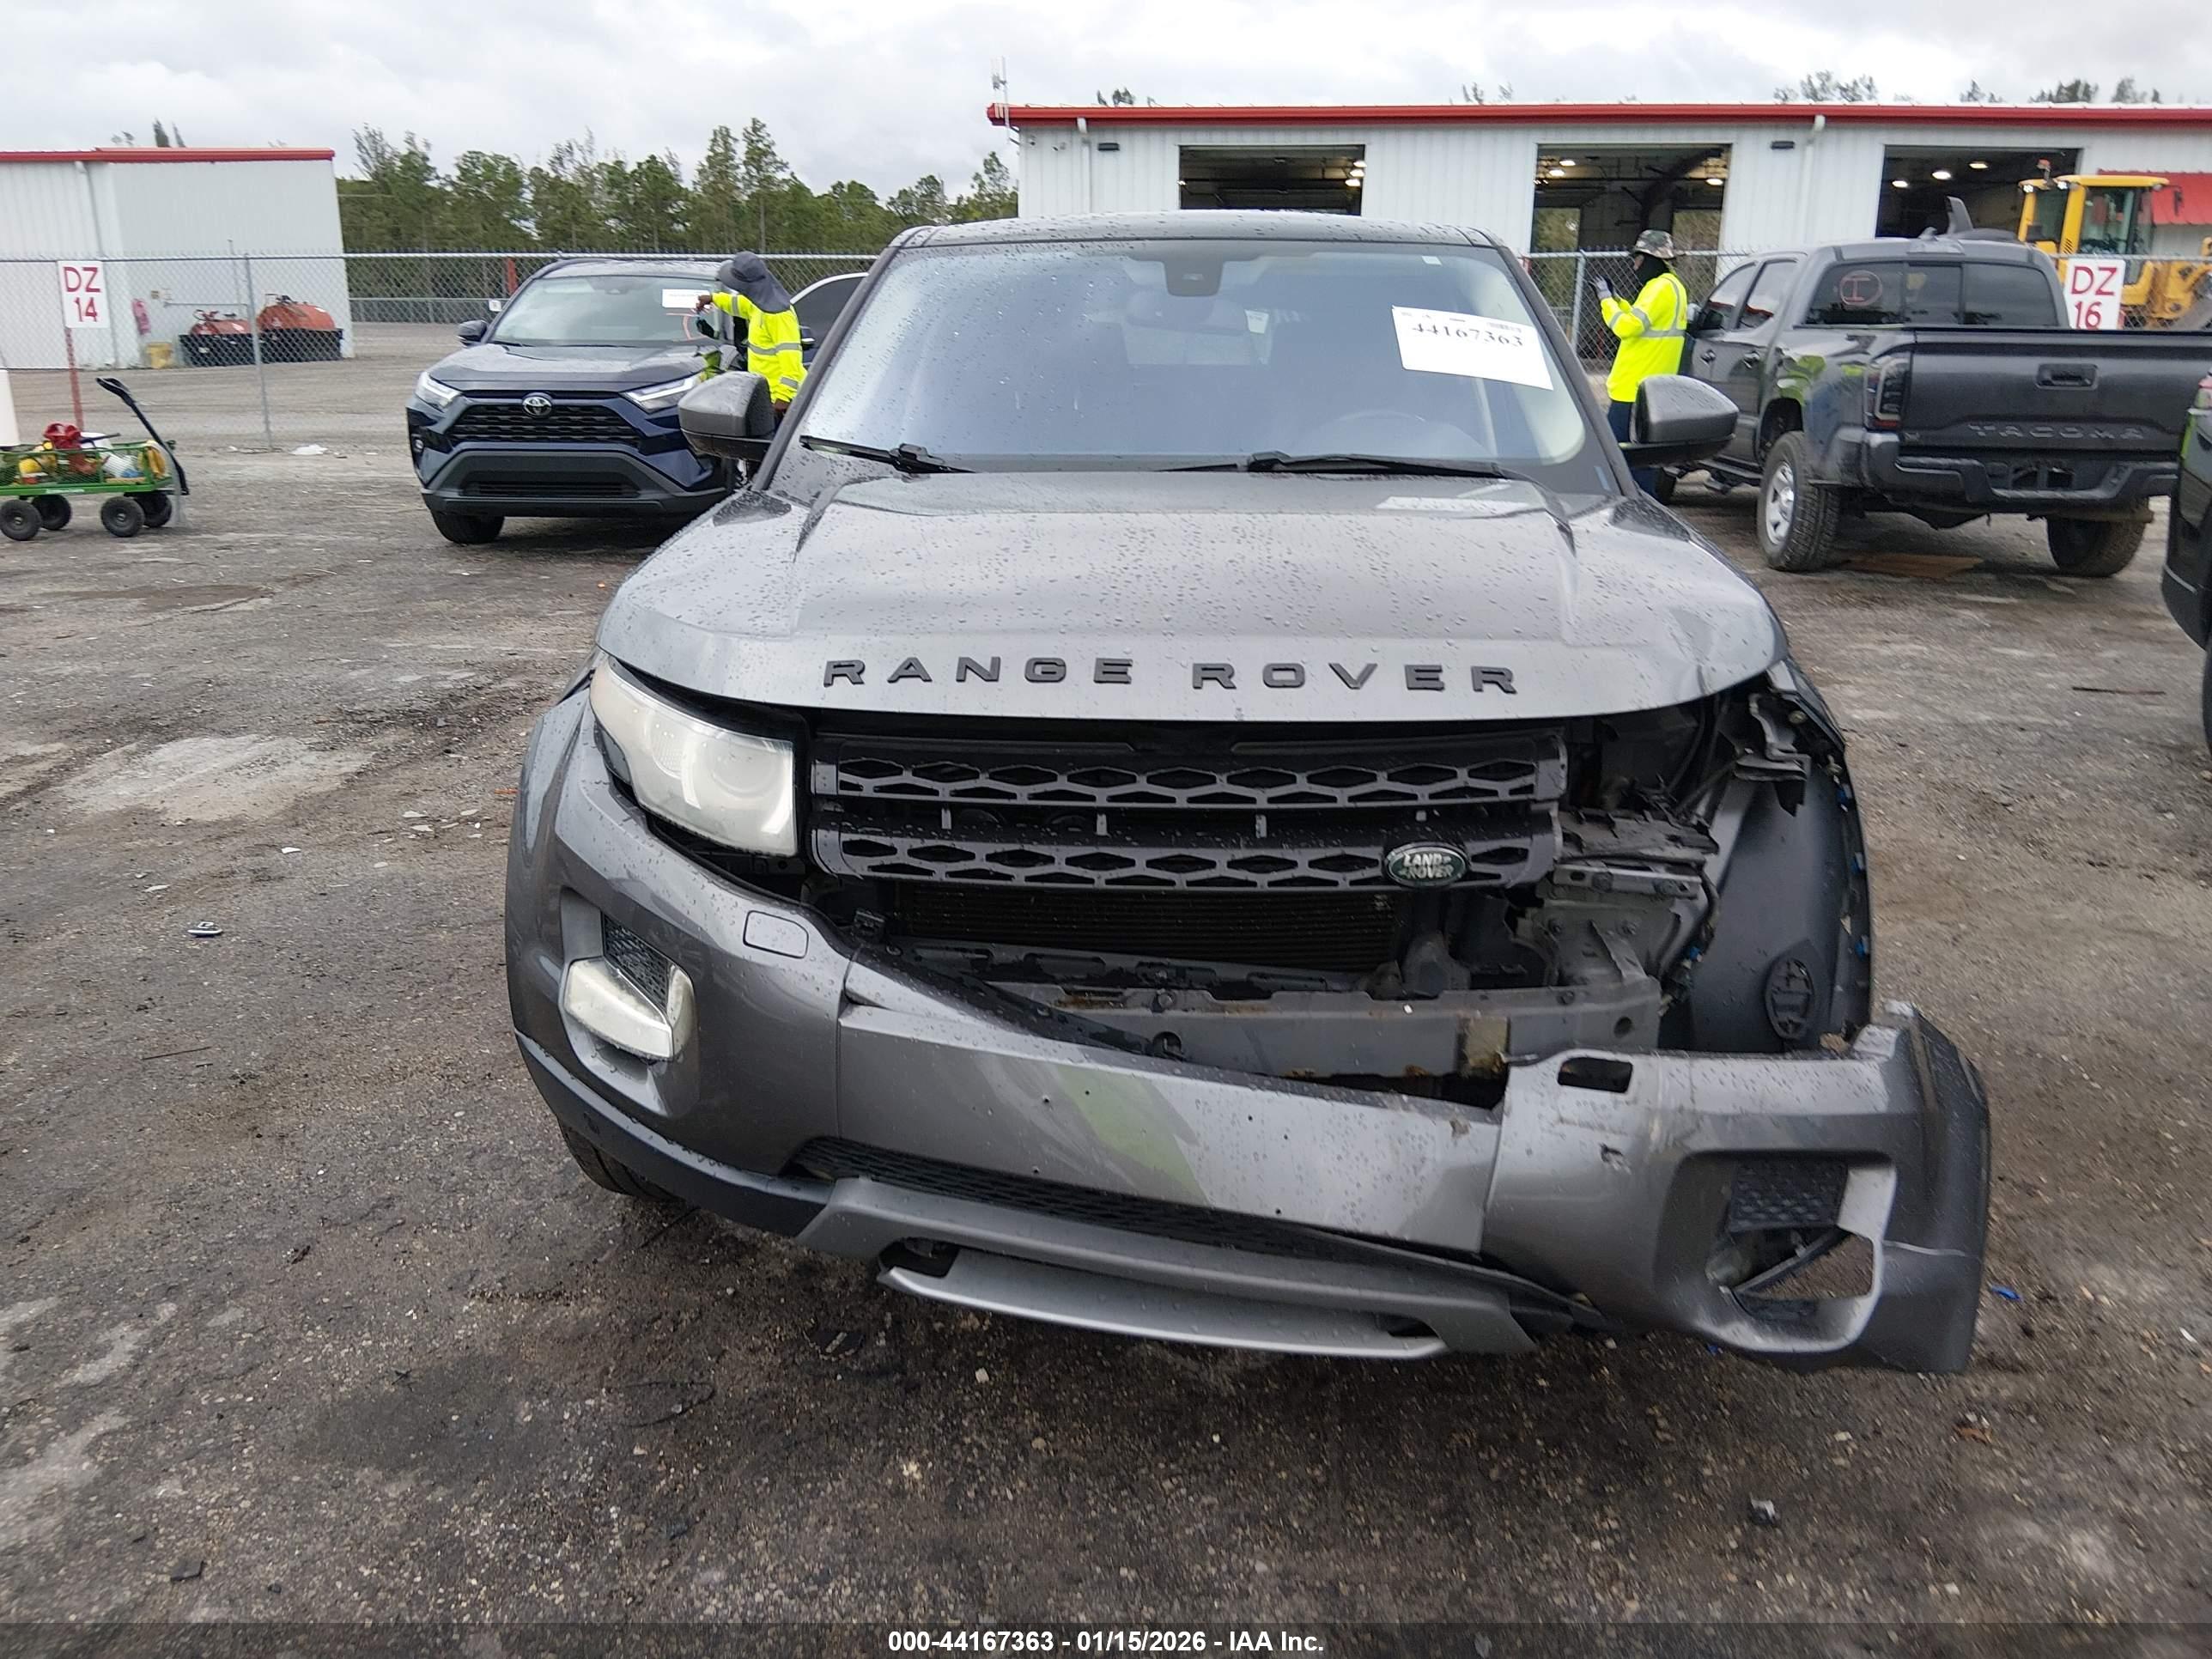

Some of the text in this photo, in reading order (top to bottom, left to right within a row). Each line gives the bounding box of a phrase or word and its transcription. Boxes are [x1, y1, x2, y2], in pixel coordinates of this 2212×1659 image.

[63, 266, 101, 293] DZ
[2071, 266, 2118, 296] DZ
[74, 297, 98, 322] 14
[2075, 301, 2102, 330] 16
[823, 656, 1517, 694] RANGE ROVER
[1403, 852, 1443, 866] LAND
